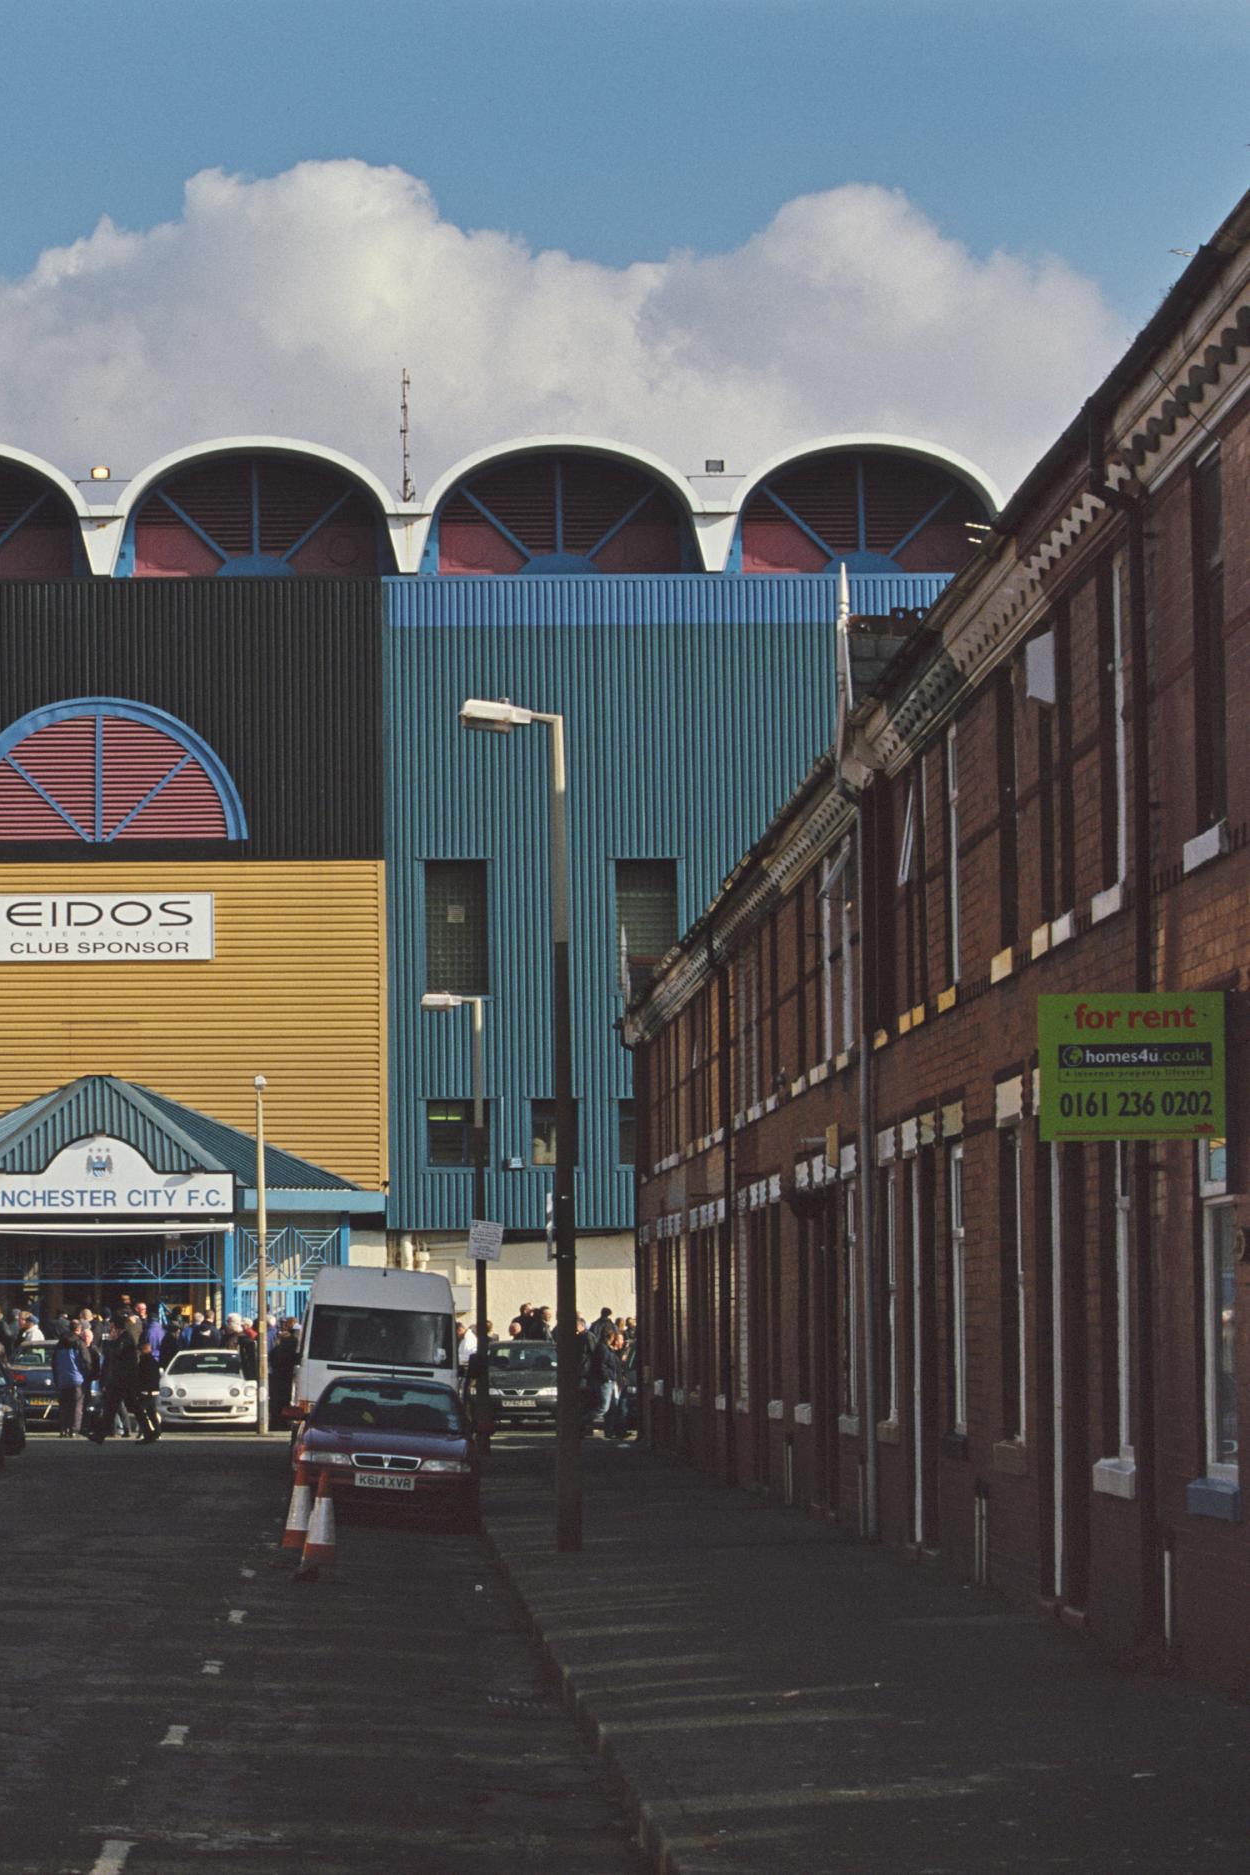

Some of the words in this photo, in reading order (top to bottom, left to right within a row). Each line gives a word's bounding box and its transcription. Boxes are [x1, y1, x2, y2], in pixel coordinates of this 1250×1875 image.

[6, 901, 193, 927] EIDOS
[10, 942, 69, 954] CLUB
[77, 941, 189, 954] SPONSOR
[1075, 1003, 1120, 1030] for
[1127, 1004, 1198, 1029] rent
[1086, 1048, 1205, 1064] homes4u.co.uk
[1060, 1092, 1108, 1117] 0161
[1117, 1091, 1155, 1117] 236
[1161, 1090, 1213, 1117] 0202
[127, 1189, 177, 1207] CITY
[187, 1189, 227, 1207] F.C.
[359, 1475, 385, 1486] K614
[388, 1477, 411, 1488] XVR
